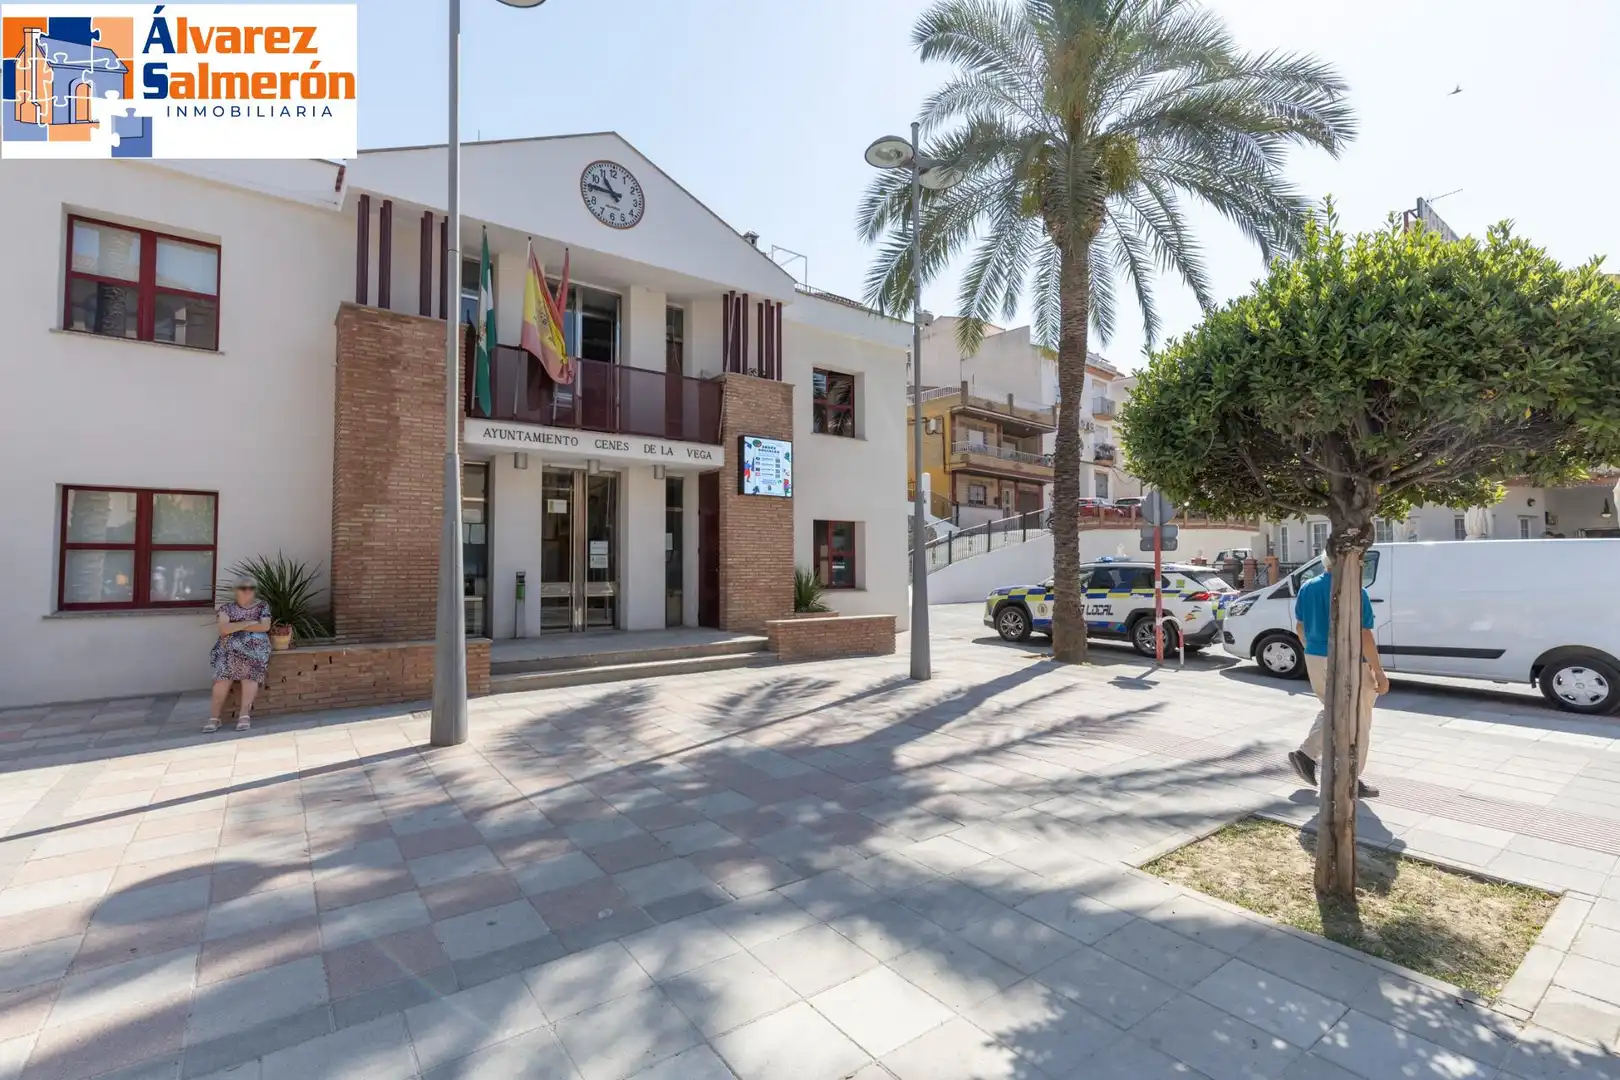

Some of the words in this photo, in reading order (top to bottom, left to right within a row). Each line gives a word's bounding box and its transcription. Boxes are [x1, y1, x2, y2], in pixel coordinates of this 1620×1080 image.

[609, 169, 617, 179] 12
[592, 174, 600, 184] 10
[630, 186, 635, 195] 2
[591, 196, 597, 205] 8
[633, 199, 638, 208] 3
[600, 206, 605, 215] 7
[628, 209, 634, 217] 4
[610, 212, 615, 221] 6
[620, 213, 625, 222] 5
[483, 428, 579, 447] AYUNTAMIENTO
[594, 439, 629, 452] CENES
[643, 443, 657, 454] DE
[661, 445, 674, 456] LA
[687, 448, 712, 460] VEGA
[1086, 604, 1114, 616] LOCAL
